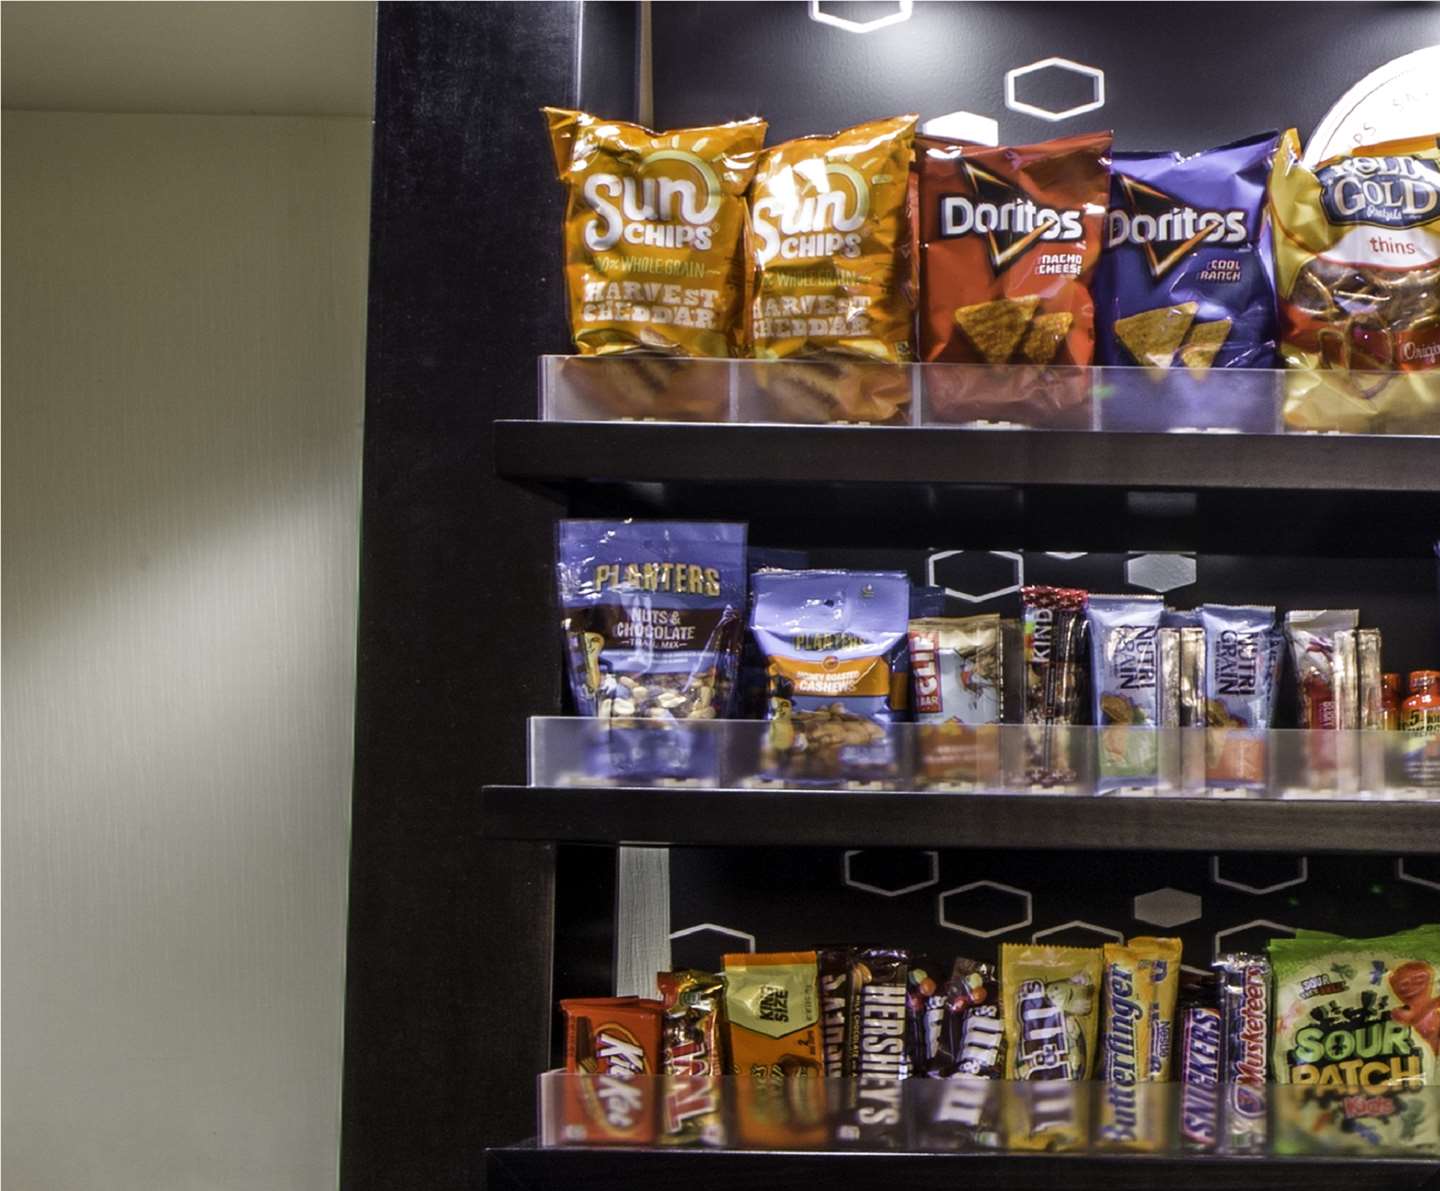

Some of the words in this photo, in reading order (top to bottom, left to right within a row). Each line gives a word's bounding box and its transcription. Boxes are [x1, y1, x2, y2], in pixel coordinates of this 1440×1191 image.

[583, 163, 720, 252] Sun
[1334, 176, 1438, 216] GOLD
[944, 196, 1083, 240] Doritos
[1108, 207, 1248, 248] Doritos
[623, 223, 713, 250] CHIPS
[779, 232, 862, 260] CHIPS
[1370, 235, 1416, 256] thins
[621, 256, 662, 274] WHOLE
[664, 259, 705, 278] GRAIN
[1038, 264, 1082, 276] CHEESE
[1041, 254, 1082, 265] NACHO
[1209, 259, 1241, 271] COOL
[1200, 270, 1241, 282] RANCH
[584, 281, 720, 309] HARVEST
[582, 301, 717, 329] CHEDDAR
[594, 563, 721, 597] PLANTERS
[616, 622, 696, 640] CHOCOLATE
[631, 607, 668, 624] NUTS
[670, 610, 681, 625] &
[1034, 608, 1053, 662] KIND
[1217, 630, 1238, 696] GRAIN
[775, 990, 789, 1022] SIZE
[852, 1014, 860, 1058] CHOCOLATE
[1104, 962, 1143, 1142] Butterfinger
[1296, 1024, 1411, 1064] SOUR
[1184, 1009, 1219, 1138] SNICKERS
[1290, 1055, 1424, 1095] PATCH
